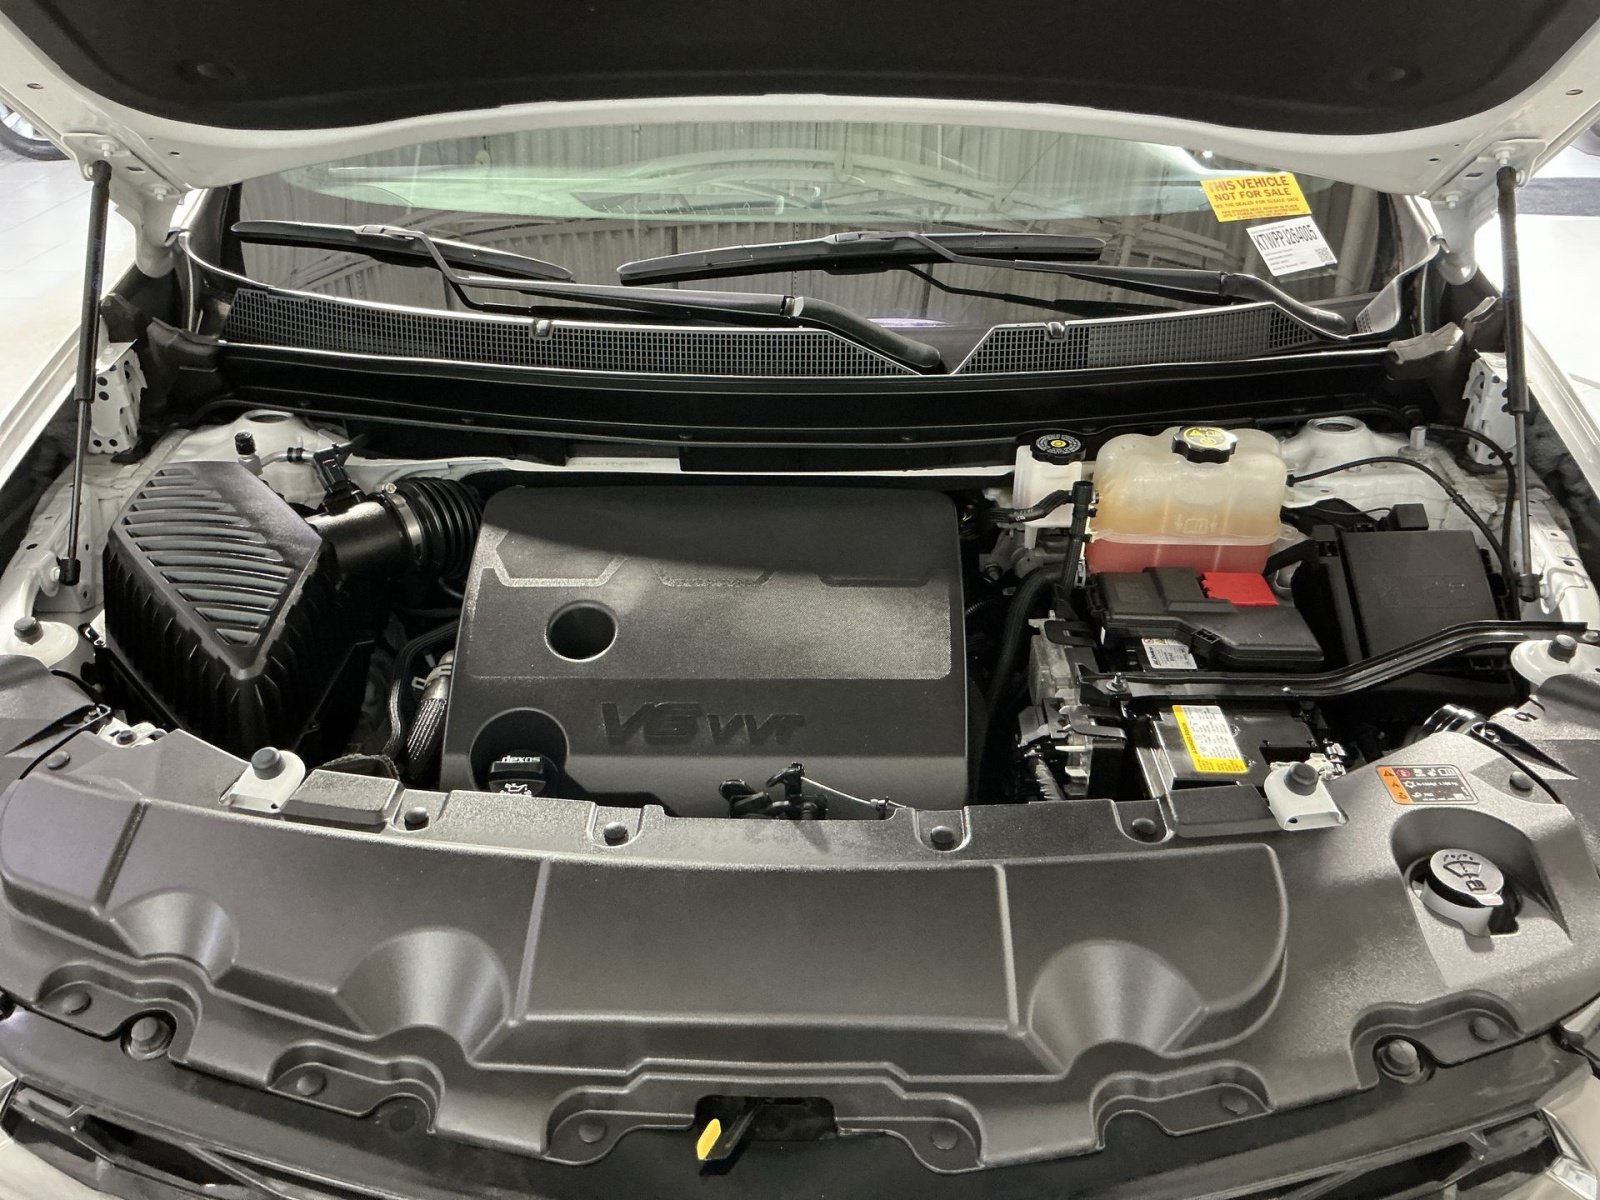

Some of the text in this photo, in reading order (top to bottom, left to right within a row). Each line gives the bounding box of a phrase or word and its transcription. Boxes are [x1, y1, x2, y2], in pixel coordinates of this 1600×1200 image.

[1207, 176, 1290, 193] THIS VEHICLE
[1214, 187, 1291, 202] NOT FOR SALE
[601, 701, 806, 745] V6 VVT
[501, 755, 541, 763] dexos
